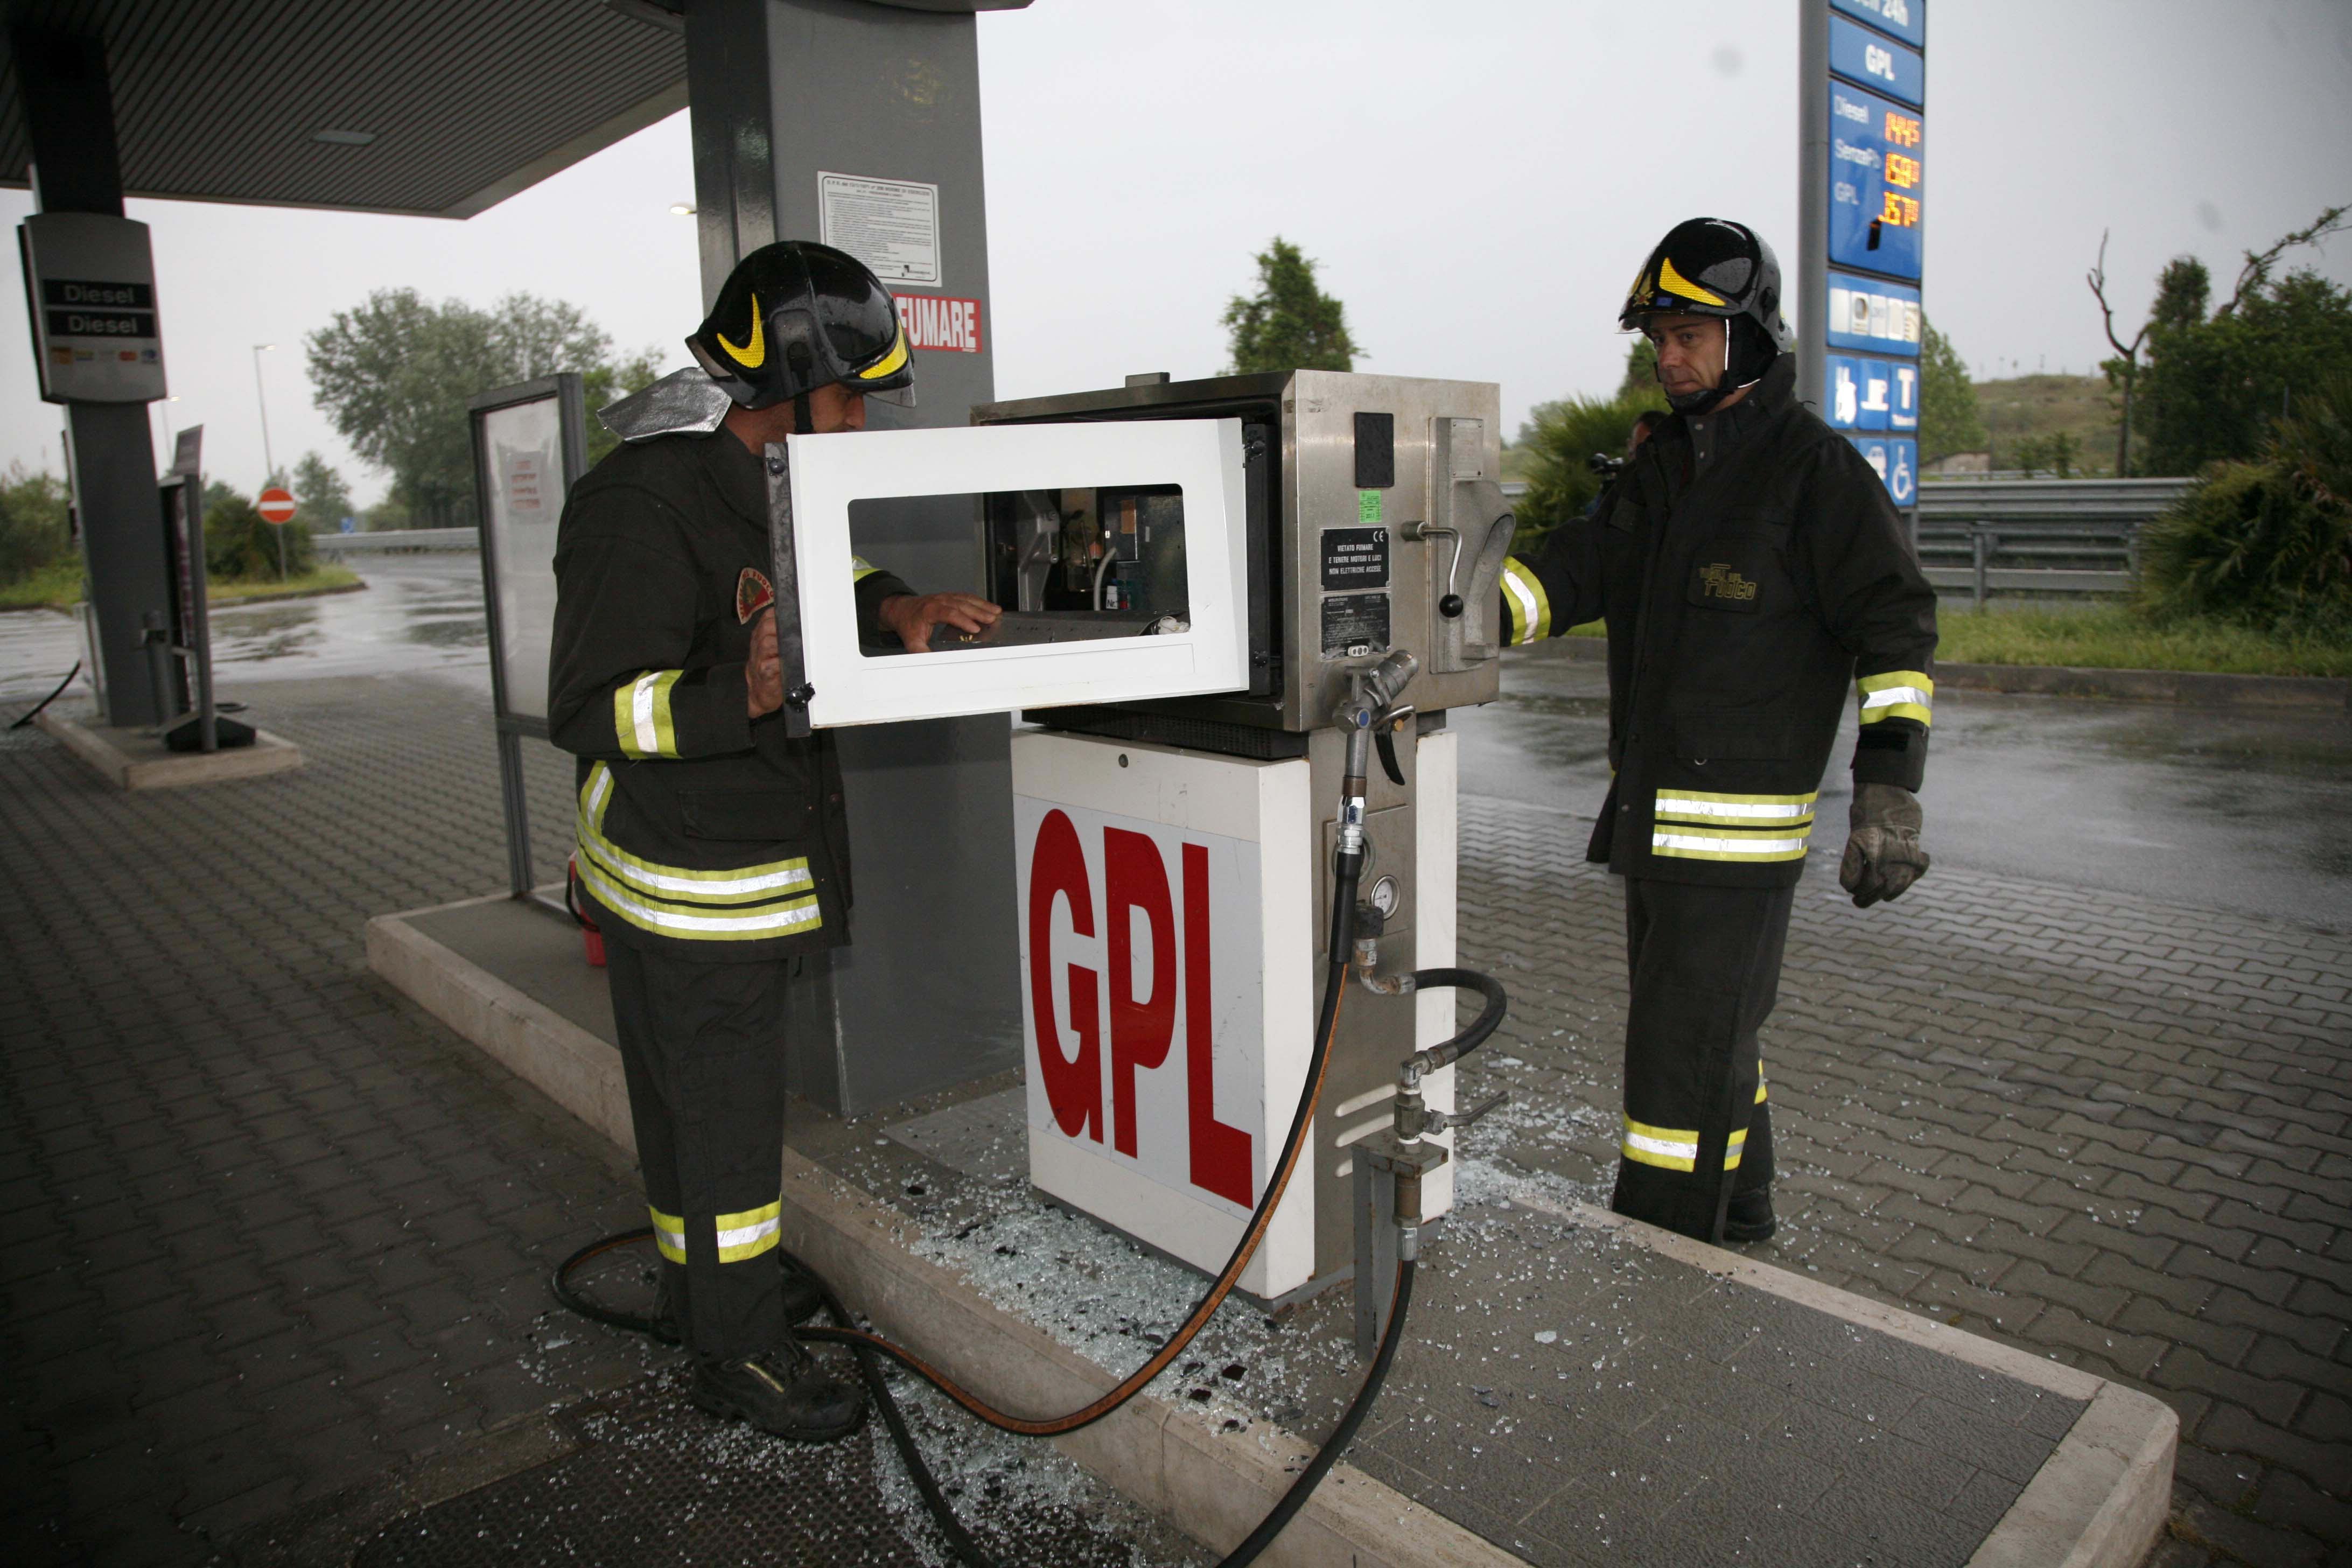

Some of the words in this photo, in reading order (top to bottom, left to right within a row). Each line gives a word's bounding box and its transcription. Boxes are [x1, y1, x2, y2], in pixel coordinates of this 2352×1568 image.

[1865, 43, 1895, 81] GPL
[1834, 95, 1869, 124] Diesel
[65, 285, 135, 304] Diesel
[69, 315, 138, 333] Diesel
[896, 297, 976, 348] FUMARE
[1340, 566, 1365, 574] ELETTRICHE
[1029, 809, 1254, 1210] GPL
